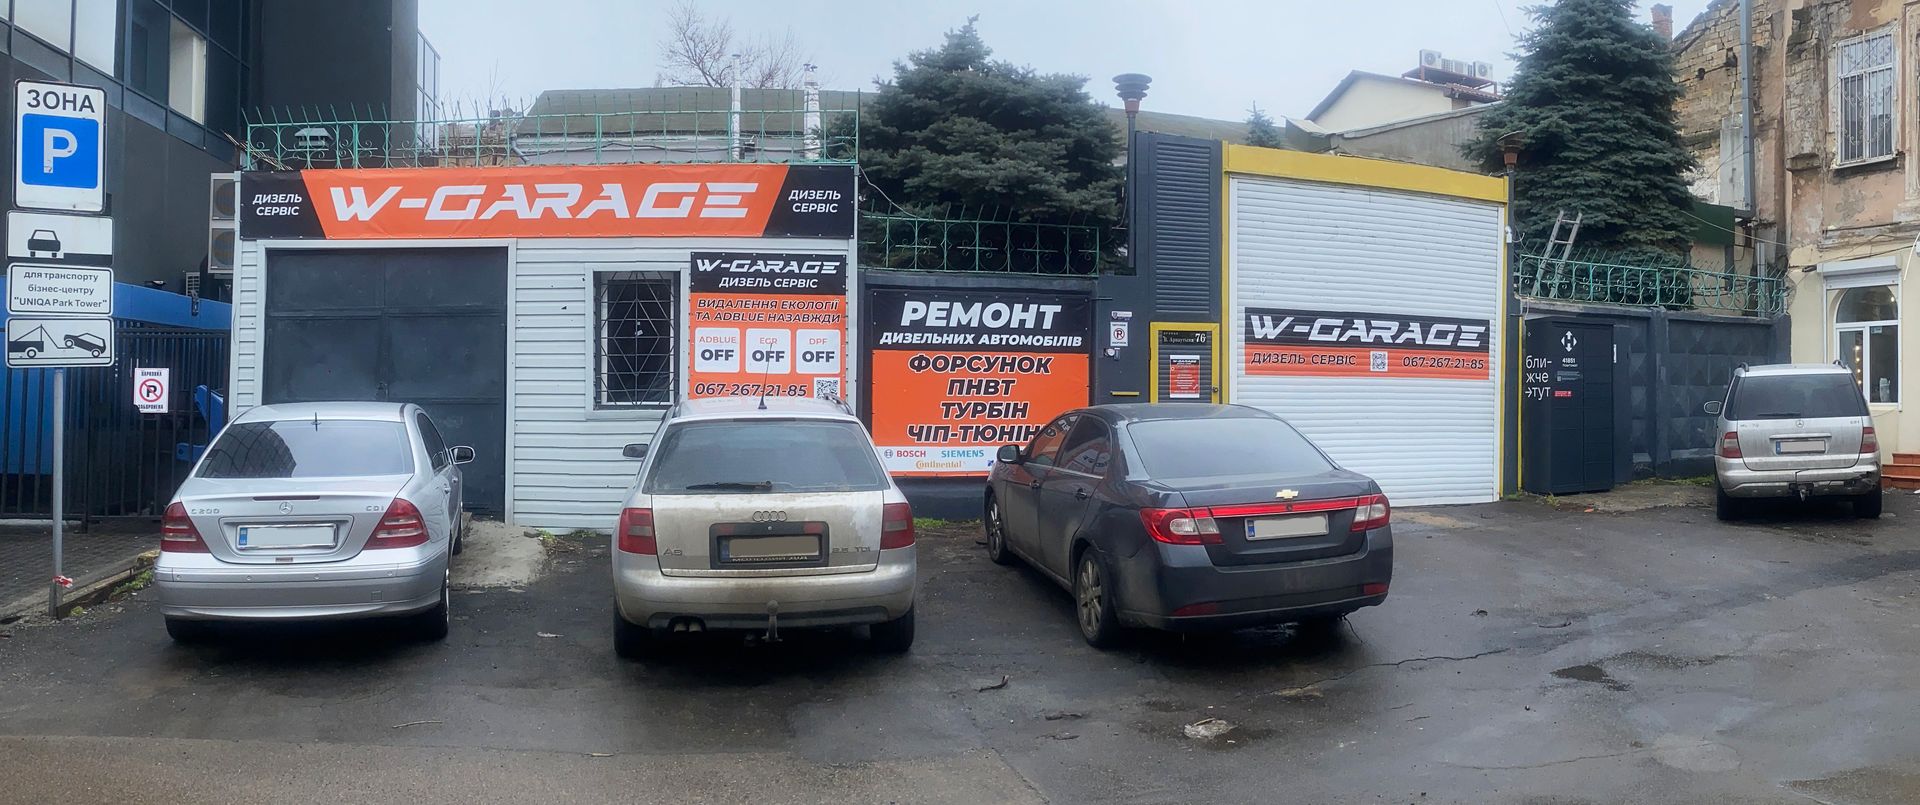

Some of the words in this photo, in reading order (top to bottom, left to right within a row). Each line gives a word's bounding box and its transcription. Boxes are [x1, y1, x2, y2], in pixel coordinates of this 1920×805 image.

[27, 89, 95, 113] ЗОНА
[43, 128, 78, 174] P
[252, 193, 302, 205] ДИЗЕЛЬ
[788, 189, 841, 202] ДИЗЕЛЬ
[329, 182, 759, 222] W-GARAGE
[792, 202, 839, 214] СЕРВІС
[256, 205, 300, 217] СЕРВІС
[696, 259, 841, 274] W-GARAGE
[24, 271, 43, 279] для
[44, 272, 99, 282] транспорту
[718, 277, 771, 288] ДИЗЕЛЬ
[774, 278, 819, 288] СЕРВІС
[28, 284, 94, 295] бізнес-центру
[14, 296, 51, 306] "UNIQA
[52, 298, 73, 307] Park
[75, 299, 107, 308] Tower"
[697, 299, 778, 310] ВИДАЛЕННЯ
[781, 299, 840, 310] ЕКОЛОГІЇ
[695, 311, 711, 321] ТА
[713, 312, 765, 322] ADBLUE
[767, 313, 841, 324] НАЗАВЖДИ
[900, 300, 1062, 330] РЕМОНТ
[1250, 314, 1487, 348] W-GARAGE
[699, 336, 737, 344] ADBLUE
[759, 337, 778, 345] EGR
[879, 331, 976, 346] ДИЗЕЛЬНИХ
[978, 333, 1082, 348] АВТОМОБІЛІВ
[1195, 333, 1206, 343] 76
[700, 349, 734, 361] OFF
[752, 350, 785, 362] OFF
[802, 351, 835, 363] OFF
[1250, 351, 1306, 366] ДИЗЕЛЬ
[1310, 354, 1357, 366] СЕРВІС
[908, 354, 1054, 375] ФОРСУНОК
[1402, 356, 1485, 370] 067-267-21-85
[1525, 355, 1552, 368] бли-
[1526, 372, 1549, 383] жче
[695, 383, 807, 397] 067-267-21-85
[947, 378, 1017, 396] ПНВТ
[1531, 387, 1551, 400] тут
[940, 401, 1029, 420] ТУРБІН
[907, 424, 1046, 444] ЧІП-ТЮНІН
[896, 450, 926, 458] BOSCH
[941, 450, 984, 458] SIEMENS
[916, 460, 962, 470] Continental
